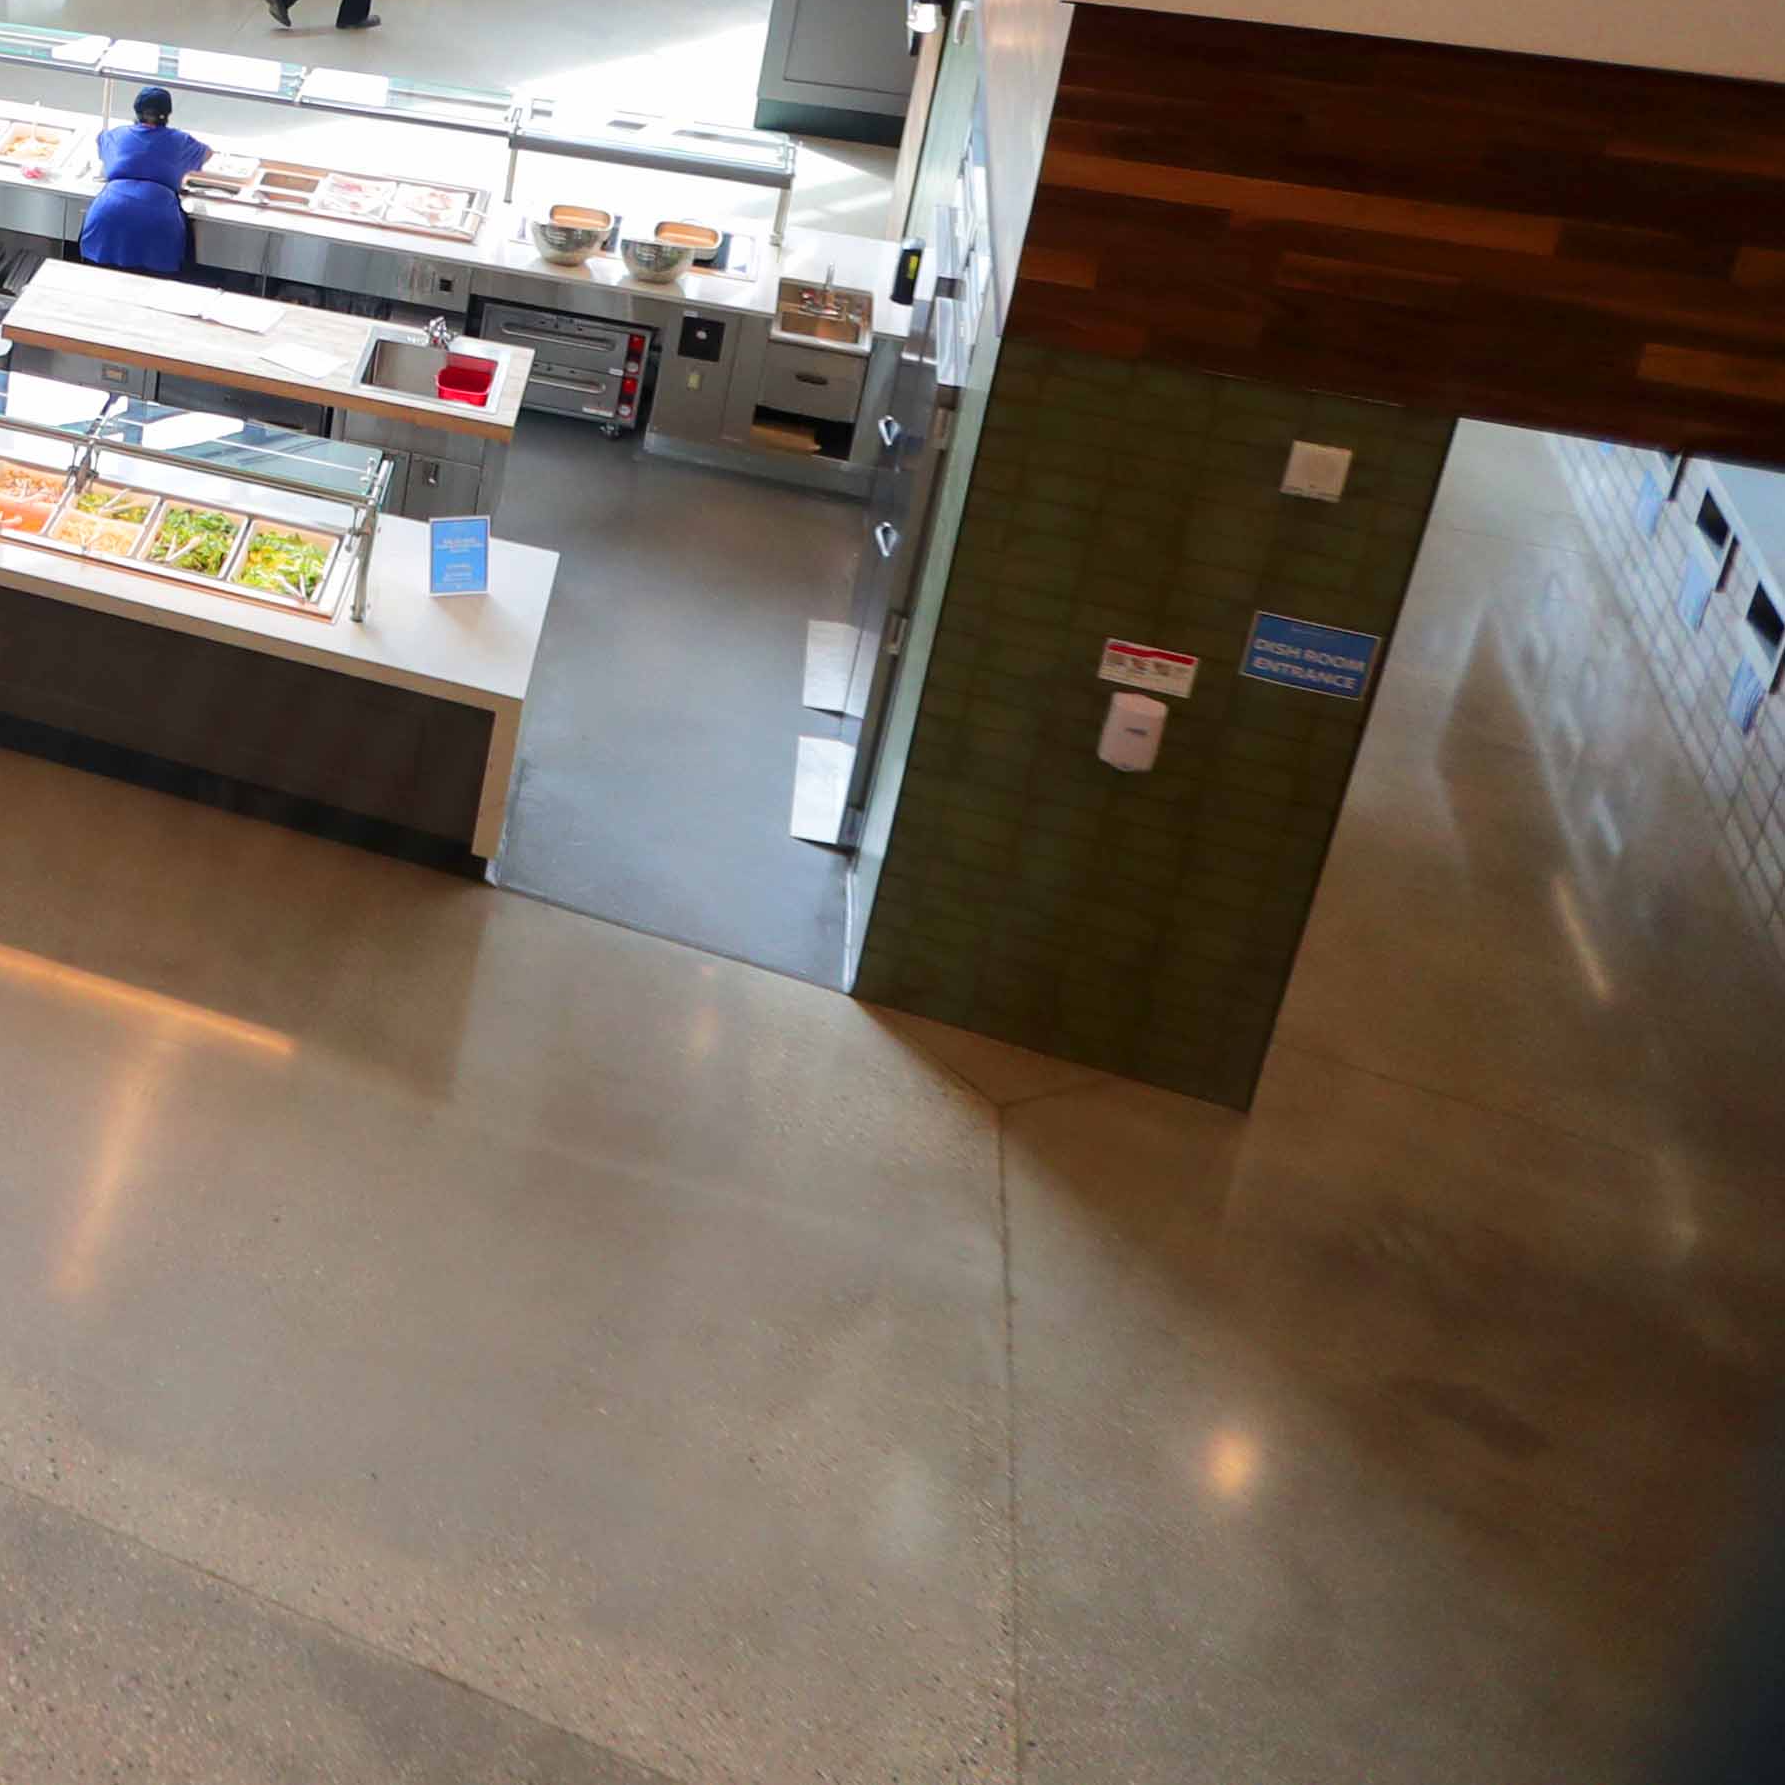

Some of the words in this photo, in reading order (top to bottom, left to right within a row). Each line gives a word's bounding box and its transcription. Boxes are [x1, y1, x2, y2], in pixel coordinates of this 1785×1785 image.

[1254, 638, 1302, 659] DISH
[1302, 646, 1366, 672] ROOM
[1253, 656, 1358, 689] ENTRANCE
